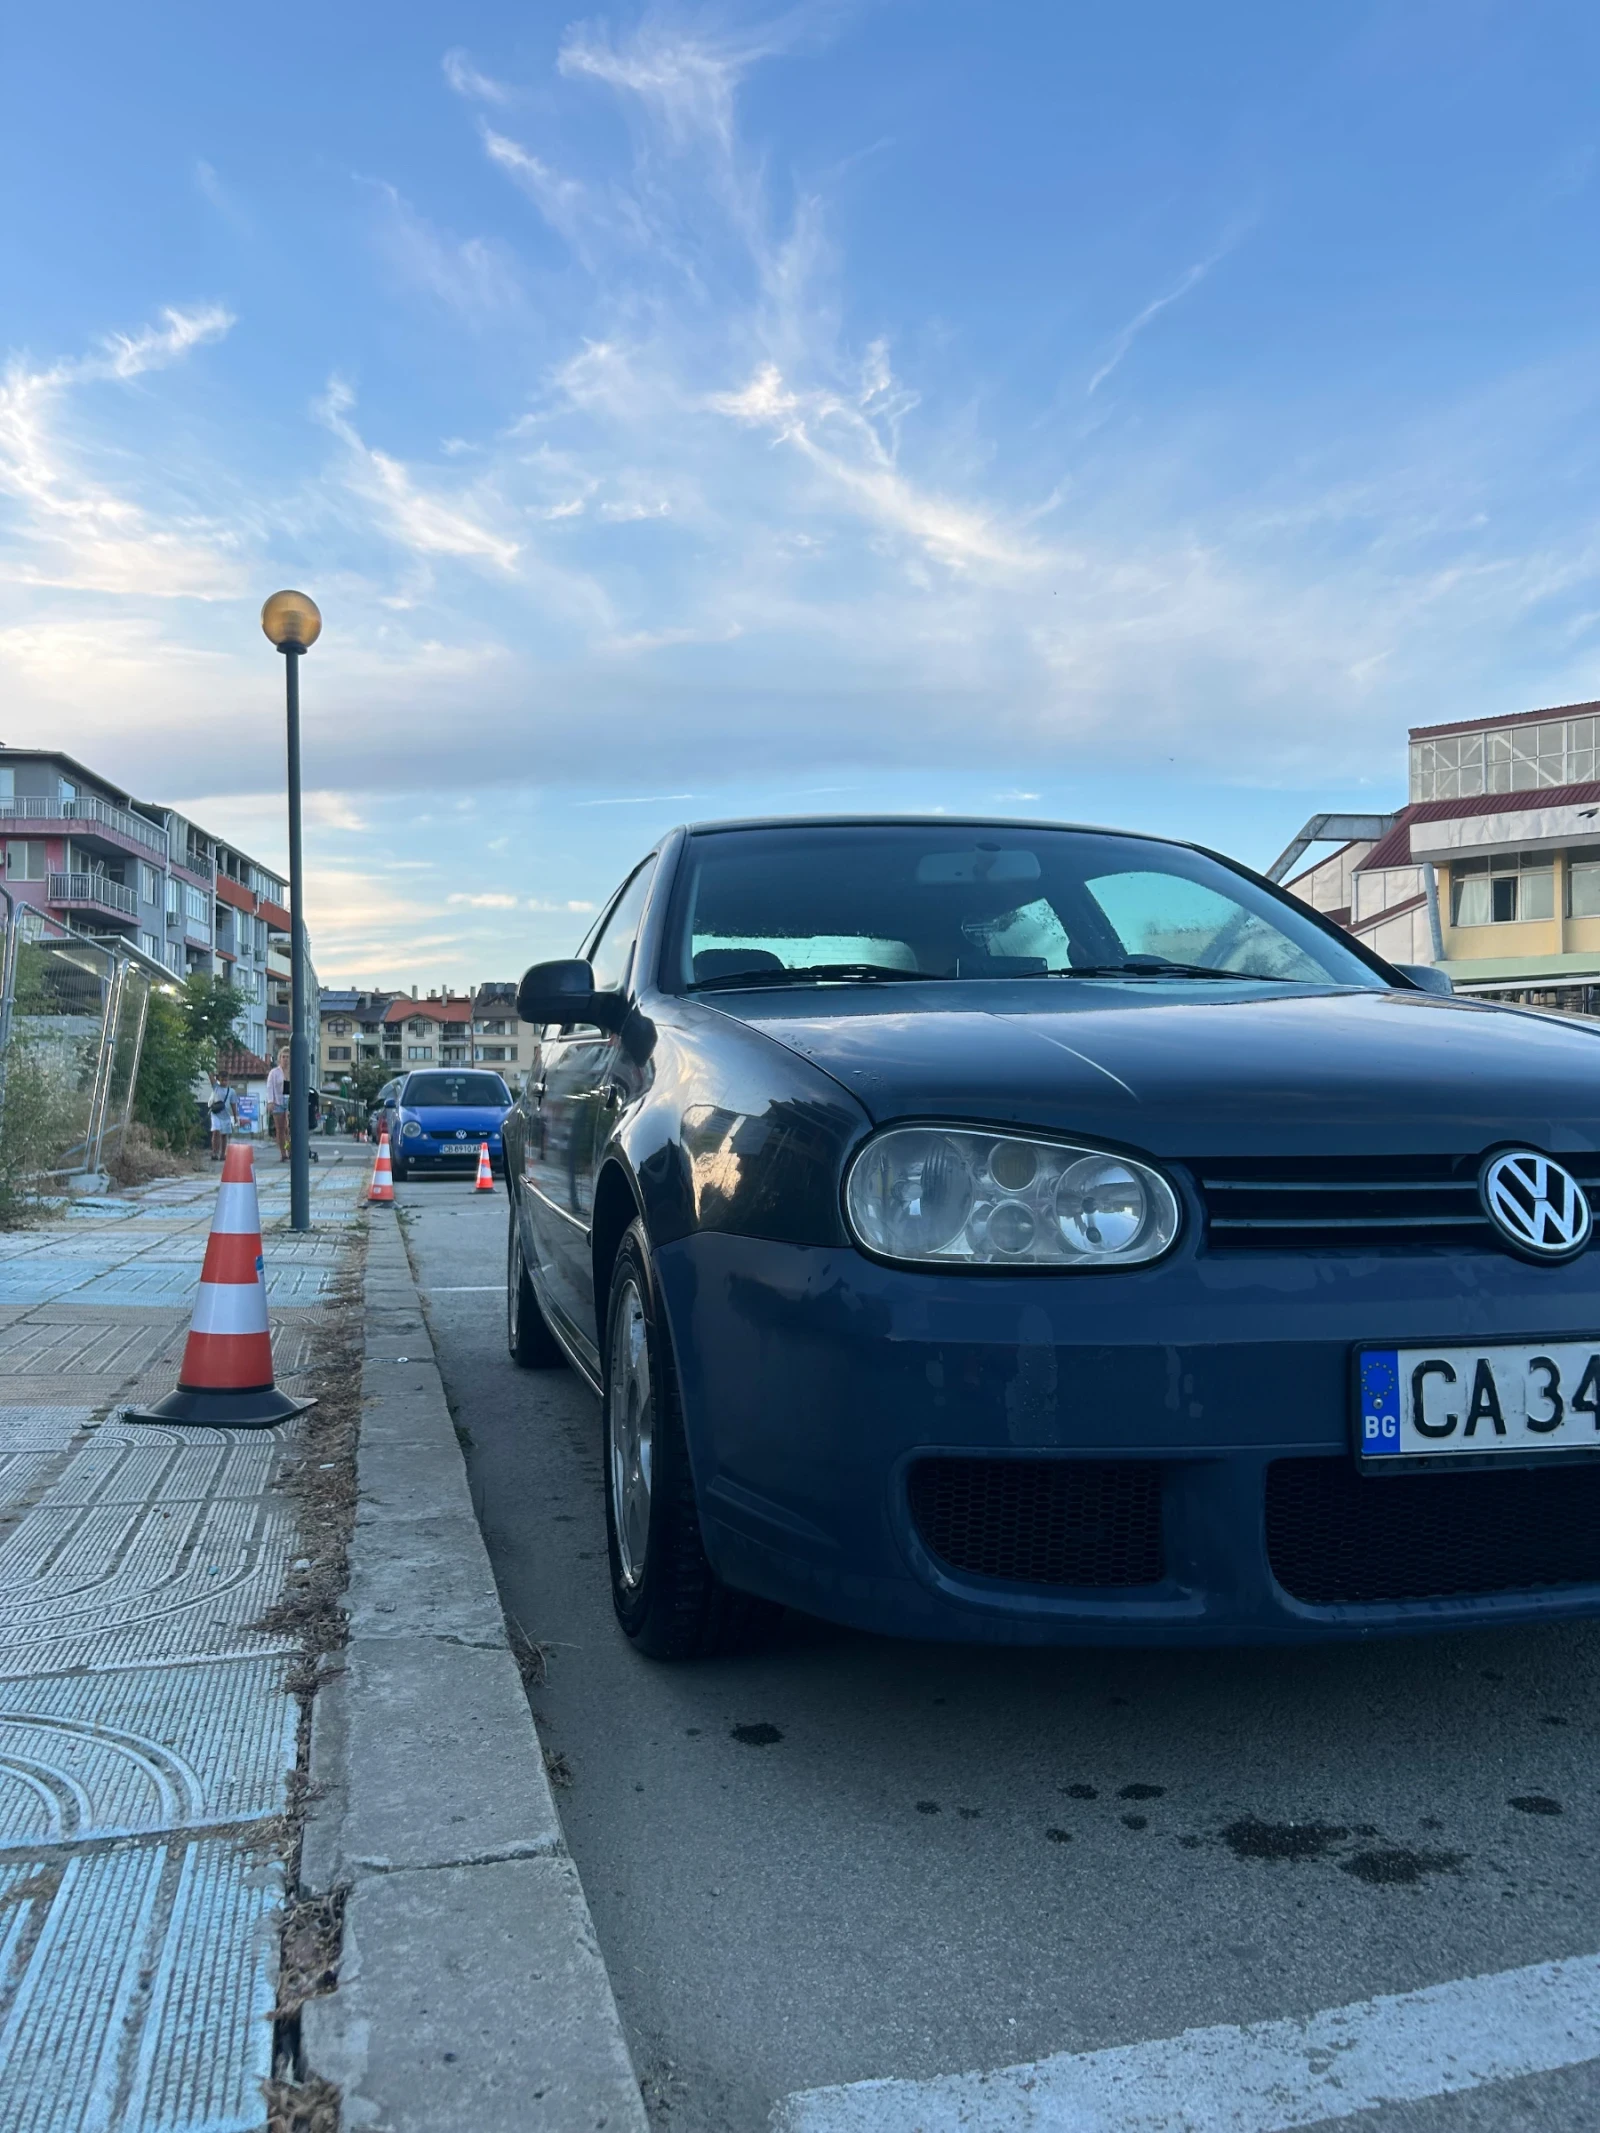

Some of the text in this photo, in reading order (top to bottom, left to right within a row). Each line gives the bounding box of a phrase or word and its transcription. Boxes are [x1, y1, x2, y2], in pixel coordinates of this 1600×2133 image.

[1488, 1153, 1588, 1249] VW
[1365, 1415, 1396, 1438] BG
[1412, 1354, 1600, 1438] CA 34
